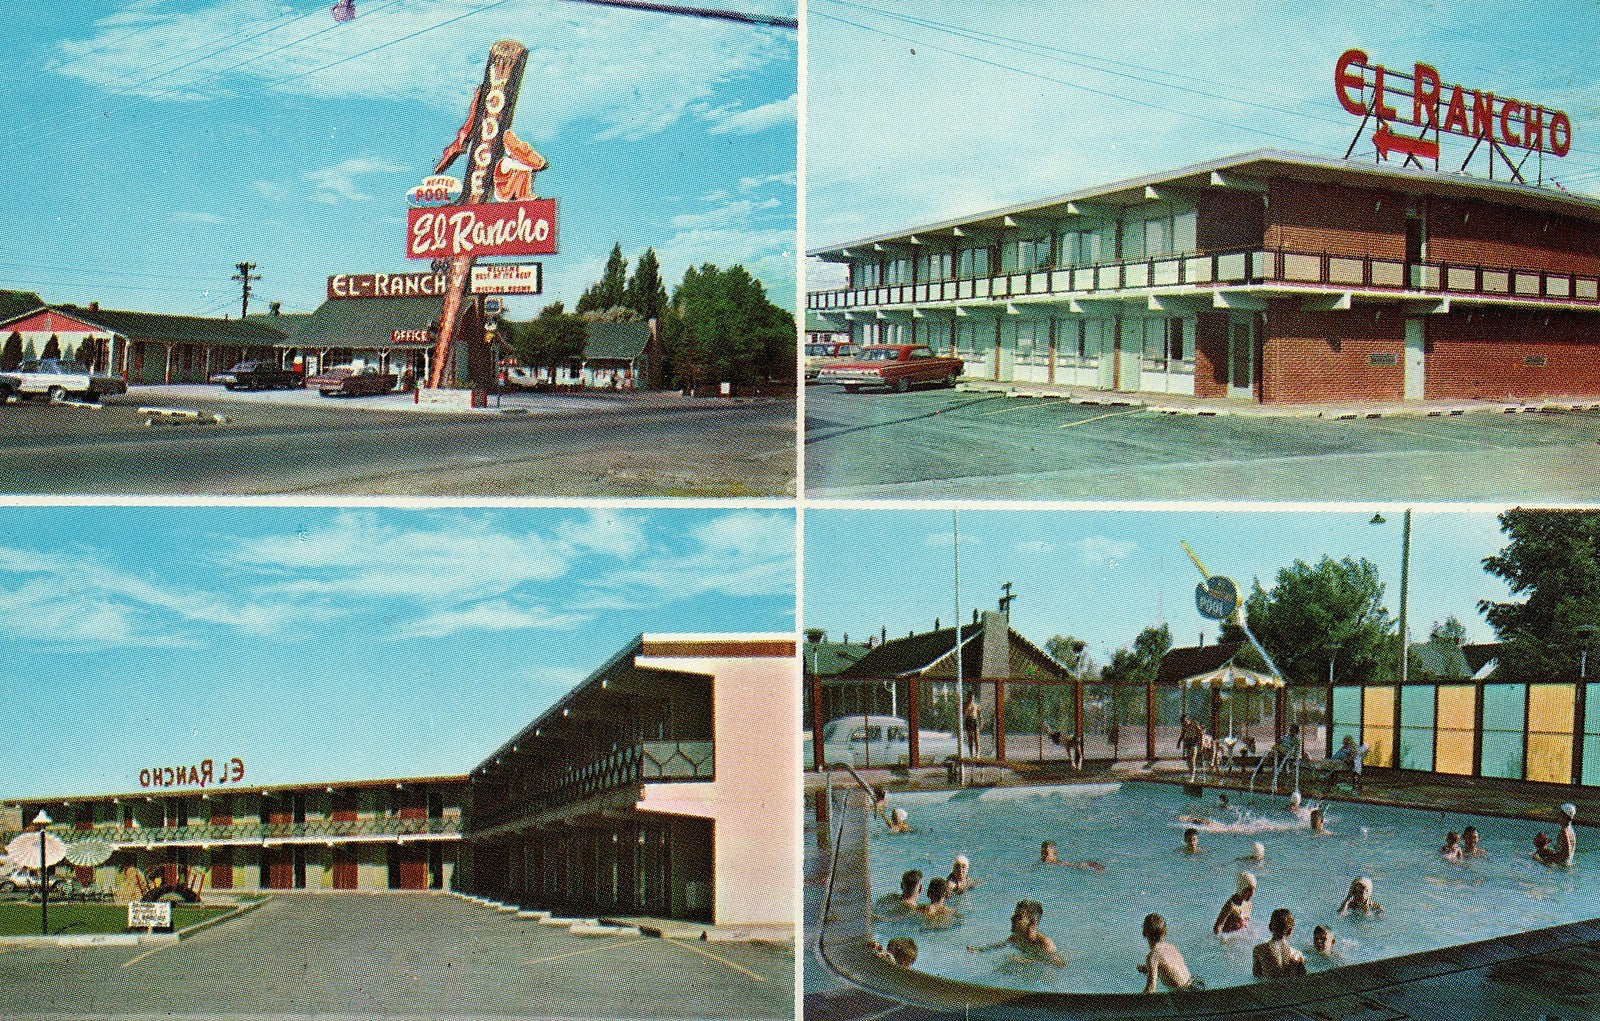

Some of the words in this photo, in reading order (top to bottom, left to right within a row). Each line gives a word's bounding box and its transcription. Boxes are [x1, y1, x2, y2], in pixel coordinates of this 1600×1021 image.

[1335, 49, 1397, 121] EL
[1413, 62, 1572, 157] RANCHO
[470, 64, 507, 196] LODGE
[415, 188, 451, 202] POOL
[412, 213, 447, 254] El
[450, 207, 549, 254] Rancho
[332, 273, 447, 297] EL-RANCH
[393, 330, 428, 341] OFFICE
[1199, 596, 1223, 616] POOL
